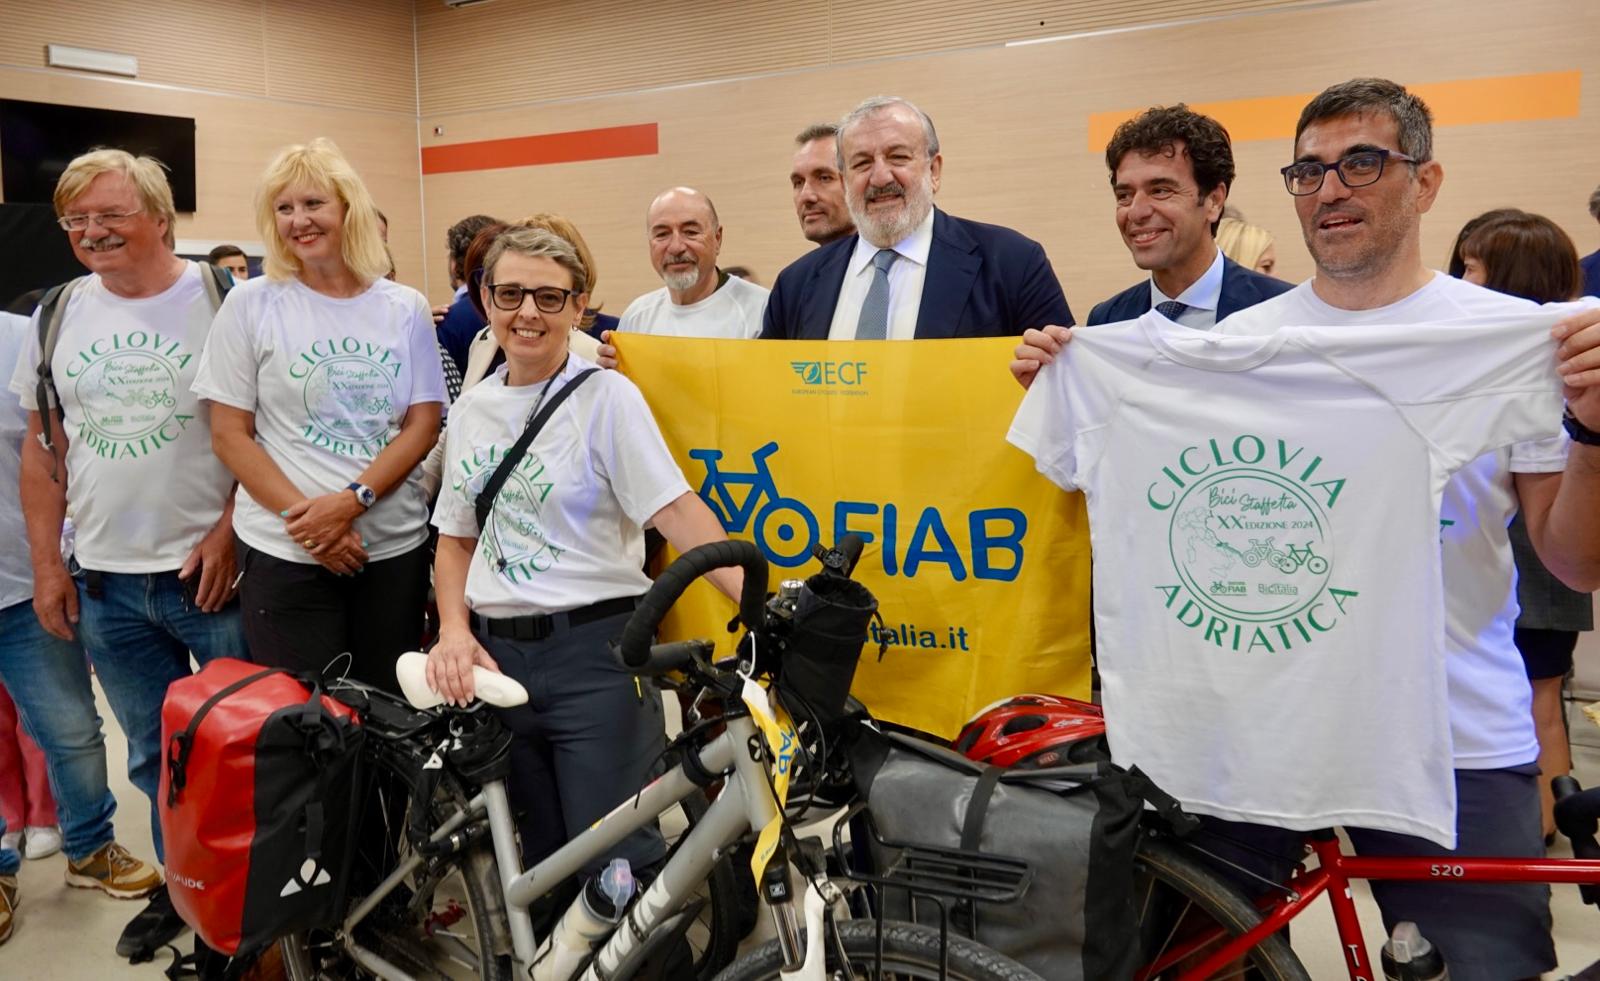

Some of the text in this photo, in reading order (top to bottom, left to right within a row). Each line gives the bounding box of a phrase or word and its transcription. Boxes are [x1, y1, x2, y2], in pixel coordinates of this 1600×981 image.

[66, 331, 193, 378] CICLOVIA
[289, 336, 402, 379] CICLOVIA
[825, 361, 868, 385] ECF
[77, 414, 195, 459] ADRIATICA
[1147, 434, 1347, 511] CICLOVIA
[1209, 487, 1297, 516] Bici Staffetta
[834, 501, 1028, 582] FIAB
[1245, 521, 1287, 529] EDIZIONE
[1291, 520, 1314, 529] 2024
[1155, 585, 1359, 653] ADRIATICA
[1431, 864, 1465, 877] 520
